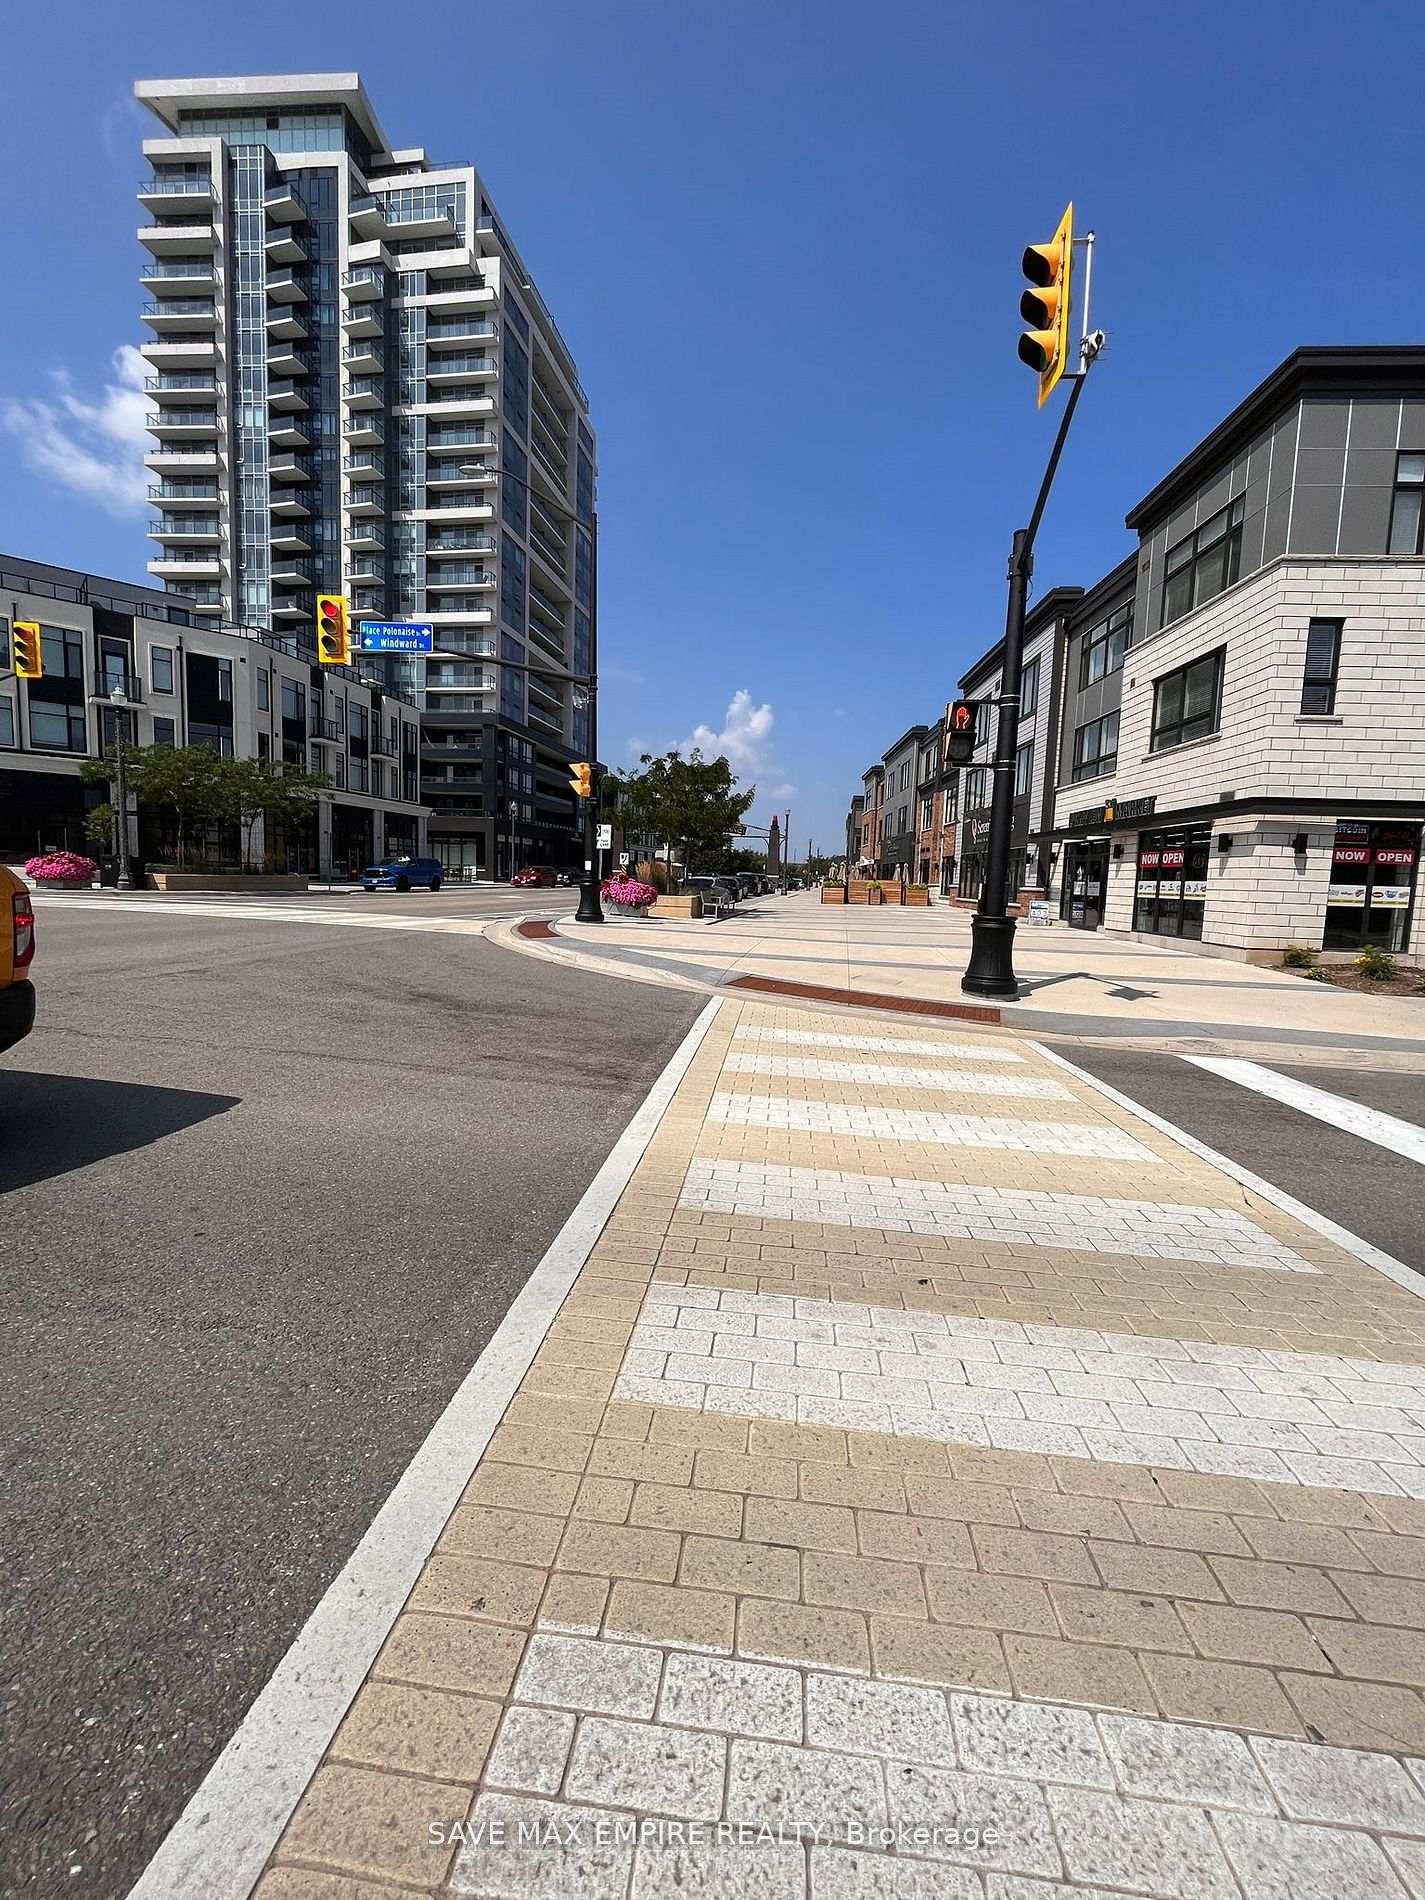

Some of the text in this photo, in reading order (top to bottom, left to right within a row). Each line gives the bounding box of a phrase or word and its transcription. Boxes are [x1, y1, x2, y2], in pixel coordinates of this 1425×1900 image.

[362, 625, 381, 635] Place
[382, 626, 415, 636] Polonaise
[380, 638, 418, 648] Windward
[1141, 853, 1160, 864] NOW
[1162, 852, 1185, 864] OPEN
[1336, 851, 1413, 862] NOW OPEN
